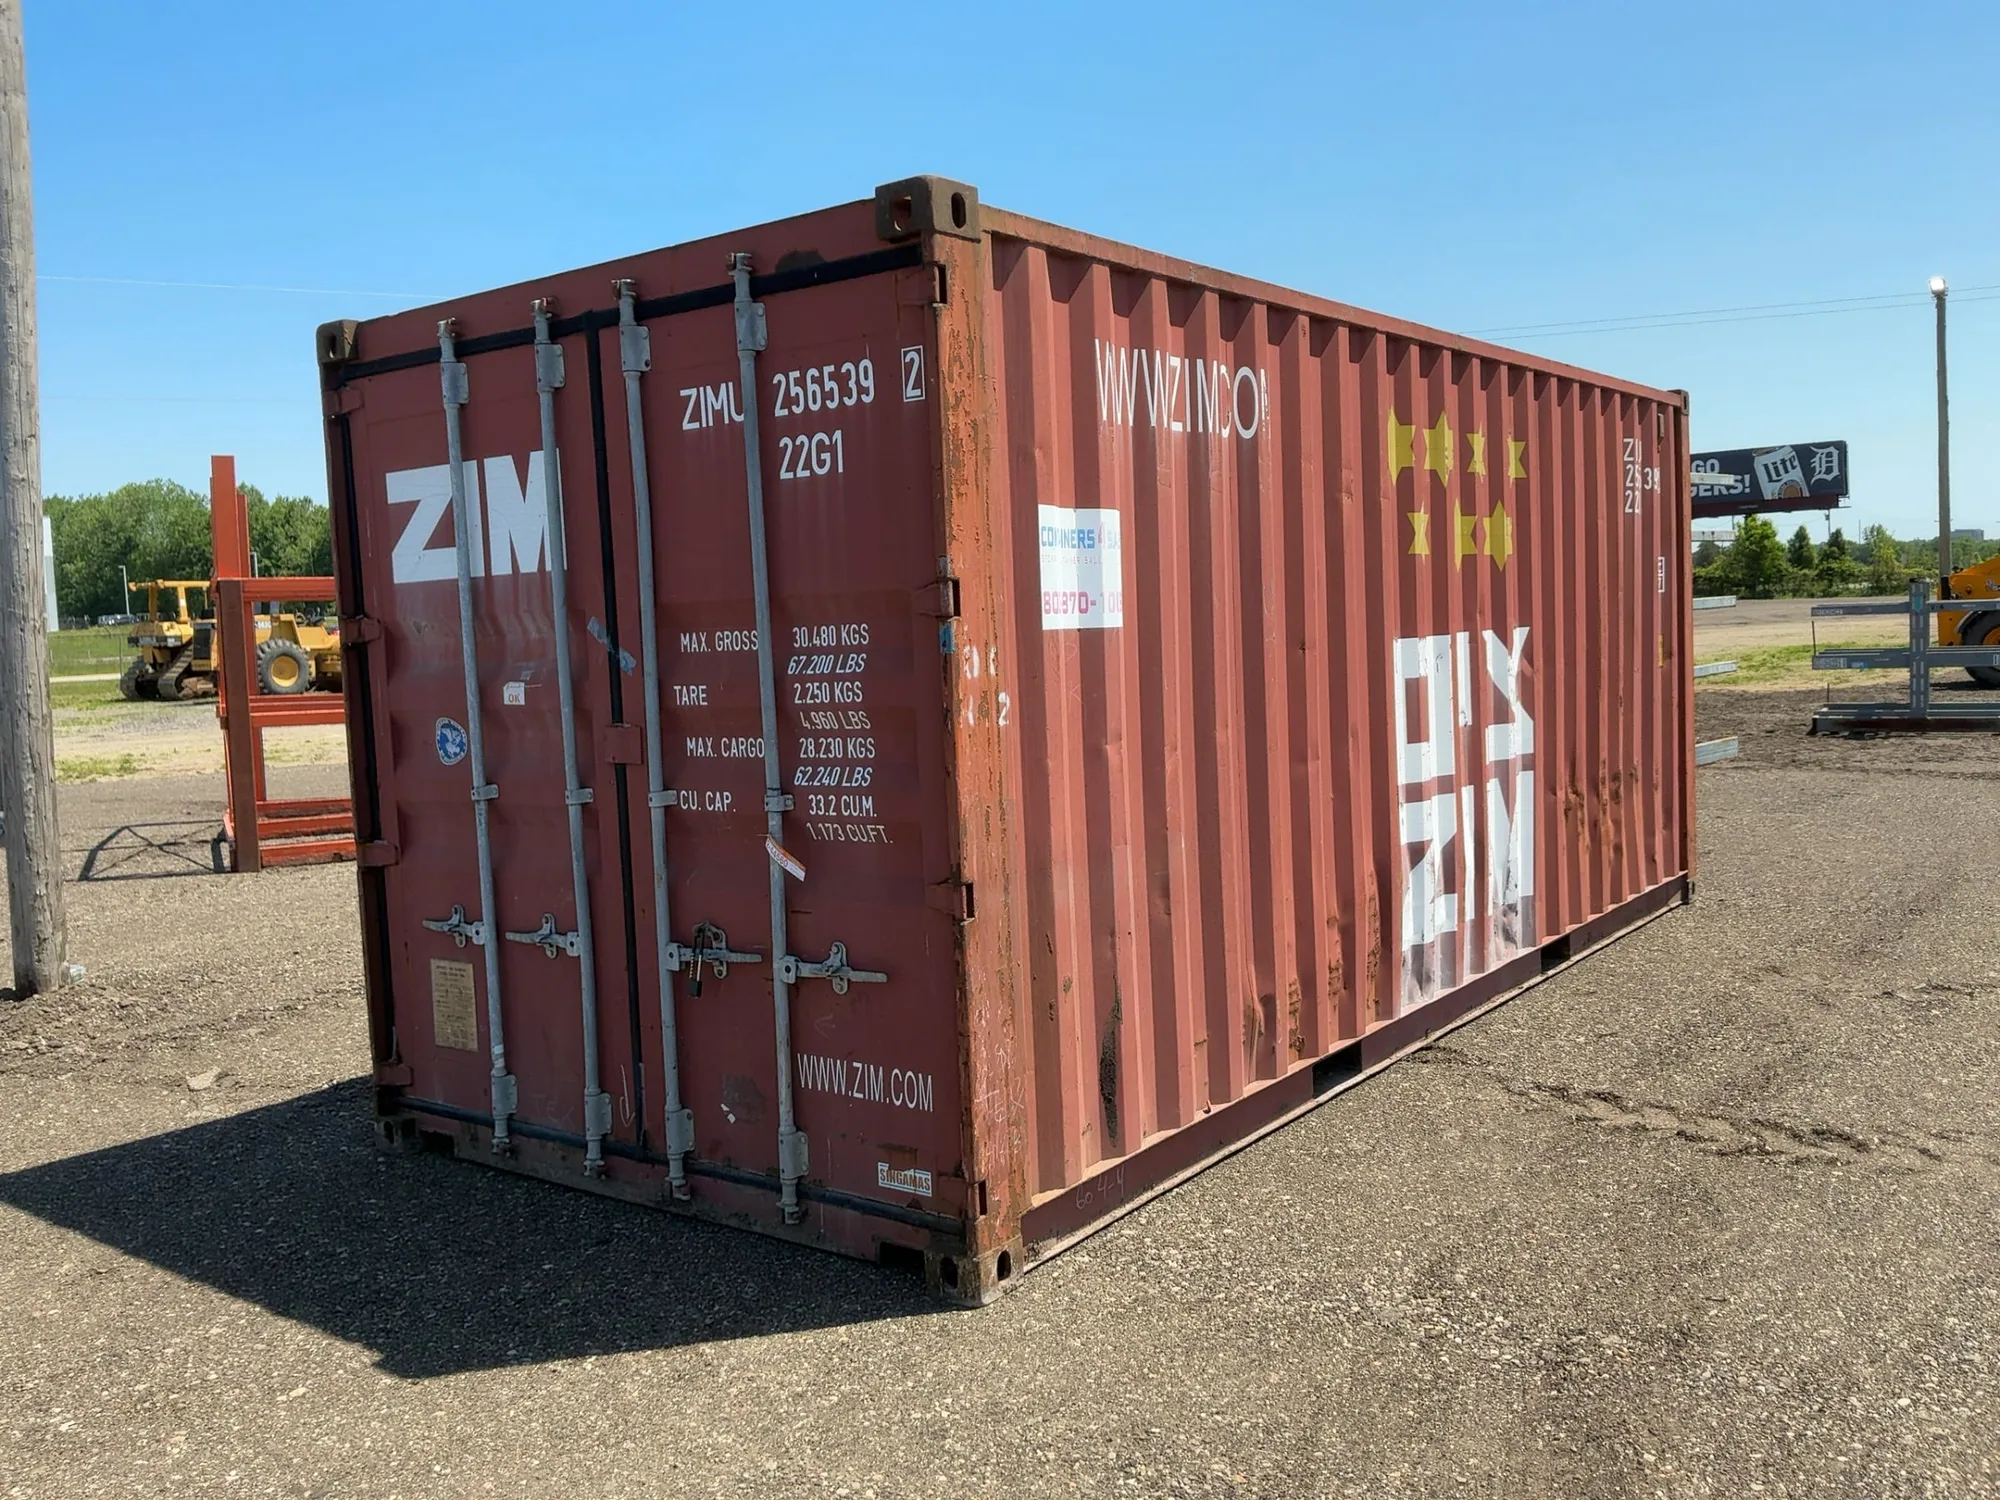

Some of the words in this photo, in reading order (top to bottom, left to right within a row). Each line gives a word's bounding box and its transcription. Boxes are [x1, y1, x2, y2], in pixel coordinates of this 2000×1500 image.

[772, 358, 875, 417] 256539
[904, 350, 923, 399] 2
[779, 429, 843, 479] 22G1
[1762, 453, 1799, 483] Lite
[385, 447, 568, 584] ZIM
[680, 632, 711, 653] MAX.
[715, 630, 759, 651] GROSS
[792, 626, 837, 648] 30.480
[841, 623, 869, 646] KGS
[787, 655, 834, 675] 67.200
[836, 653, 867, 673] LBS
[673, 685, 708, 706] TARE
[794, 683, 830, 704] 2.250
[835, 681, 863, 703] KGS
[800, 711, 839, 730] 4.960
[840, 710, 871, 730] LBS
[686, 736, 717, 758] MAX.
[721, 737, 765, 758] CARGO
[799, 738, 842, 759] 28.230
[847, 737, 876, 759] KGS
[794, 766, 839, 787] 62.240
[842, 767, 873, 787] LBS
[680, 790, 701, 812] CU.
[706, 791, 736, 813] CAP.
[808, 795, 837, 816] 33.2
[806, 822, 845, 842] 1.173
[1400, 770, 1534, 951] ZIM
[797, 1053, 933, 1112] WWW.ZIM.COM
[879, 1168, 931, 1191] SINGAMAS
